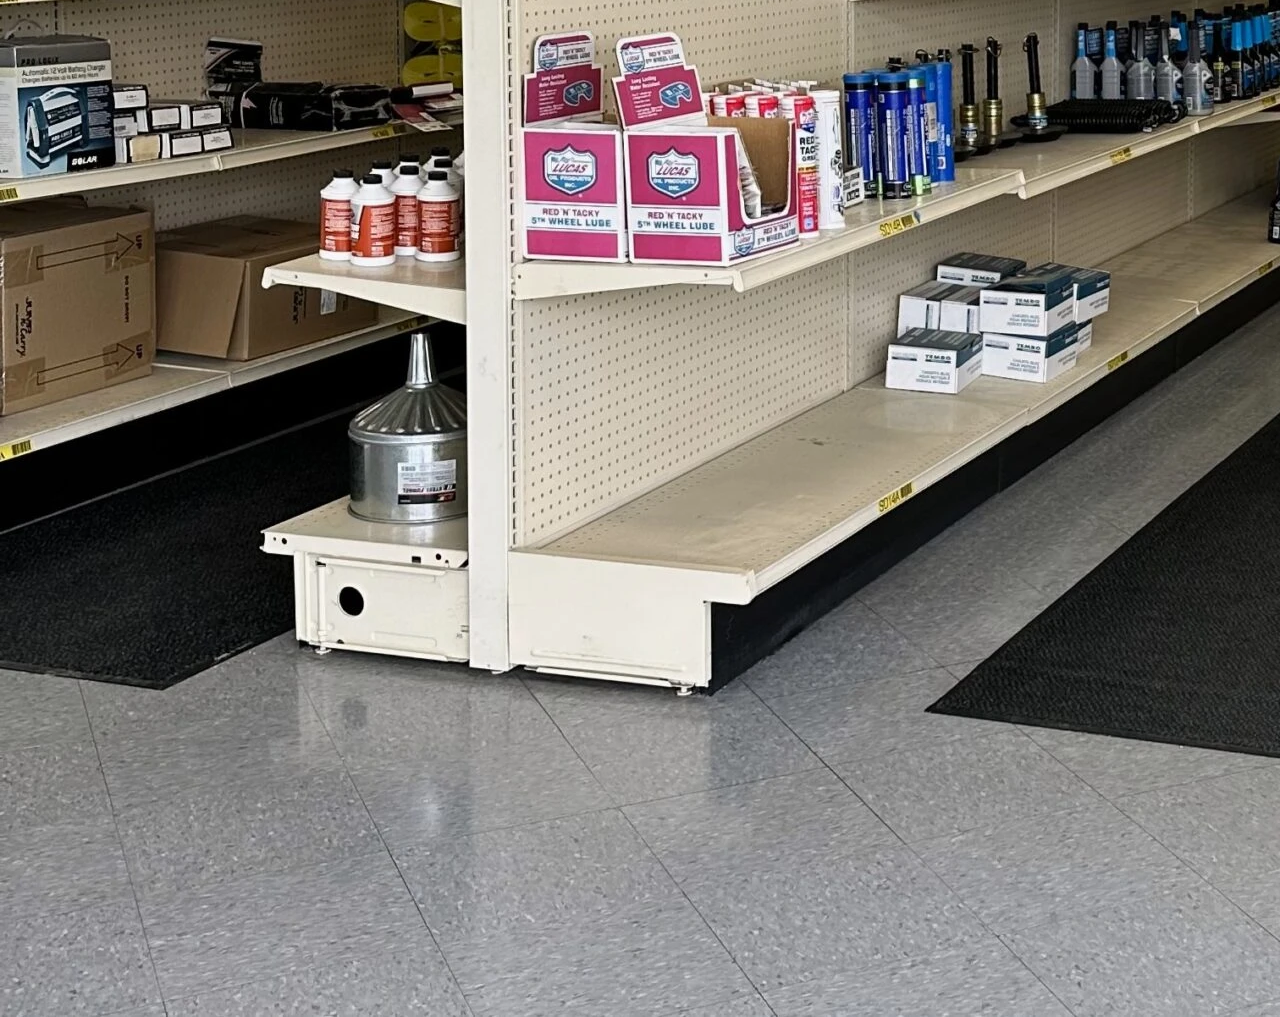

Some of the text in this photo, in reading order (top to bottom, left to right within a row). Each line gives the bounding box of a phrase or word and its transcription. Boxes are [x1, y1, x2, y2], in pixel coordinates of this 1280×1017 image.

[57, 66, 68, 74] Volt
[68, 65, 87, 74] Battery
[87, 64, 106, 72] Charger
[800, 136, 815, 146] RED
[800, 145, 816, 155] TAC
[71, 155, 98, 166] SOLAR
[552, 163, 589, 174] LUCAS
[656, 165, 691, 176] LUCAS
[542, 208, 559, 216] RED
[572, 209, 600, 218] TACKY
[648, 211, 664, 220] RED
[676, 212, 703, 221] TACKY
[532, 217, 612, 227] 5TH WHEEL LUBE
[637, 220, 715, 230] 5TH WHEEL LUBE
[136, 235, 142, 250] UP
[136, 344, 143, 359] UP
